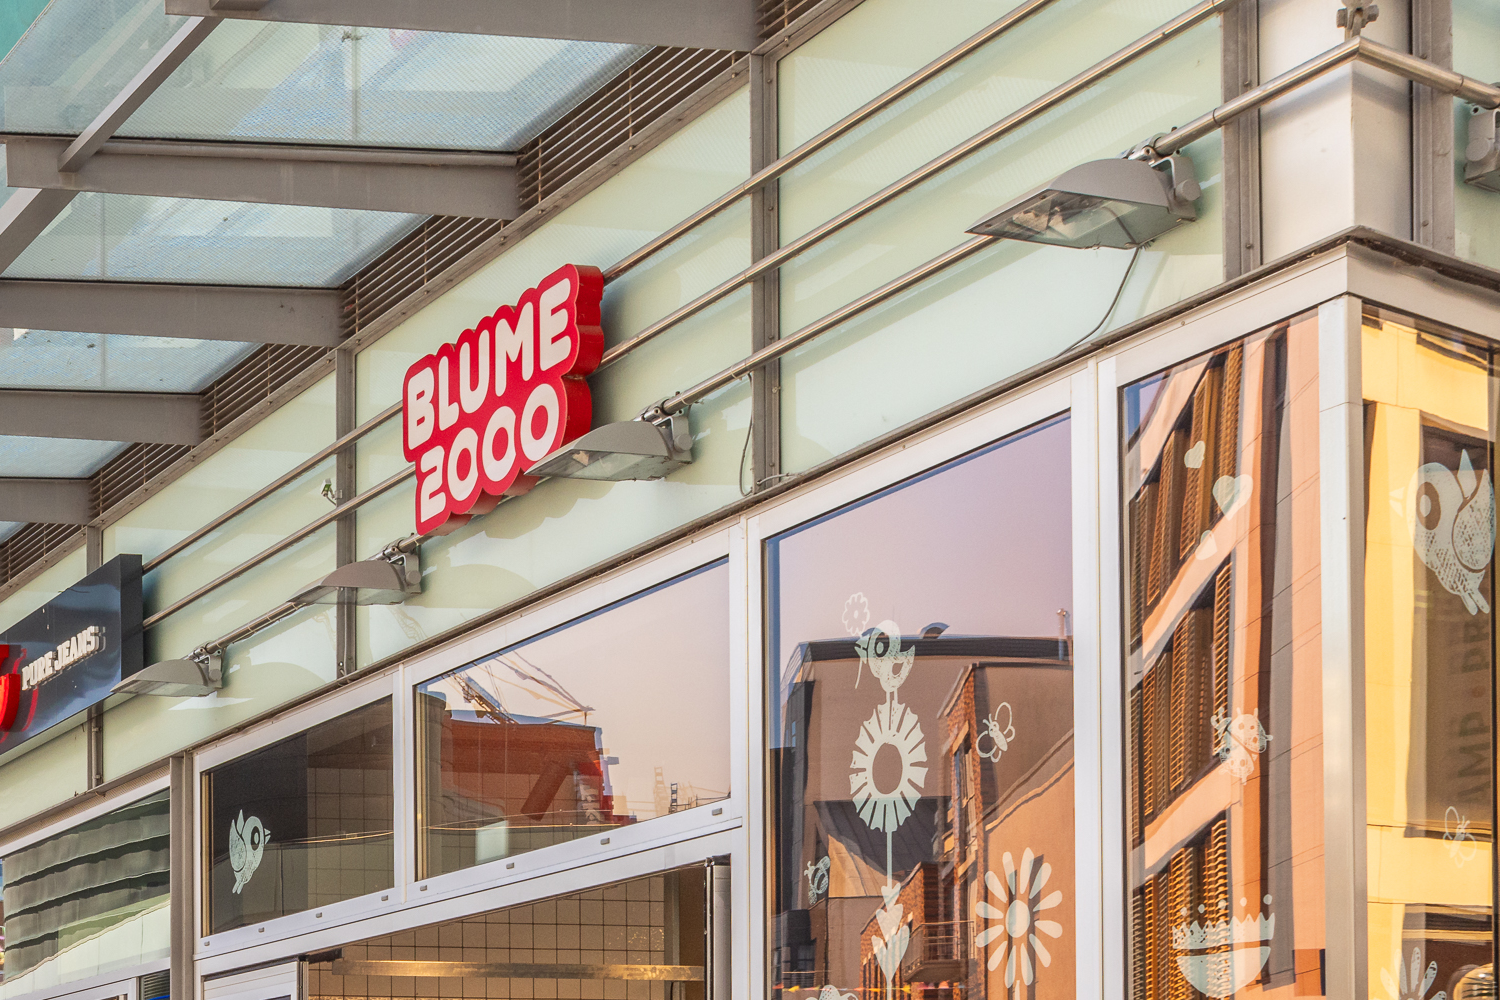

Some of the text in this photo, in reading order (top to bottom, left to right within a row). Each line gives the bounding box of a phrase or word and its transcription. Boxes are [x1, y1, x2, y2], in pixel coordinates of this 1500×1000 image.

[407, 278, 572, 450] BLUME
[420, 383, 560, 523] 2000
[21, 625, 102, 691] PURE JEANS
